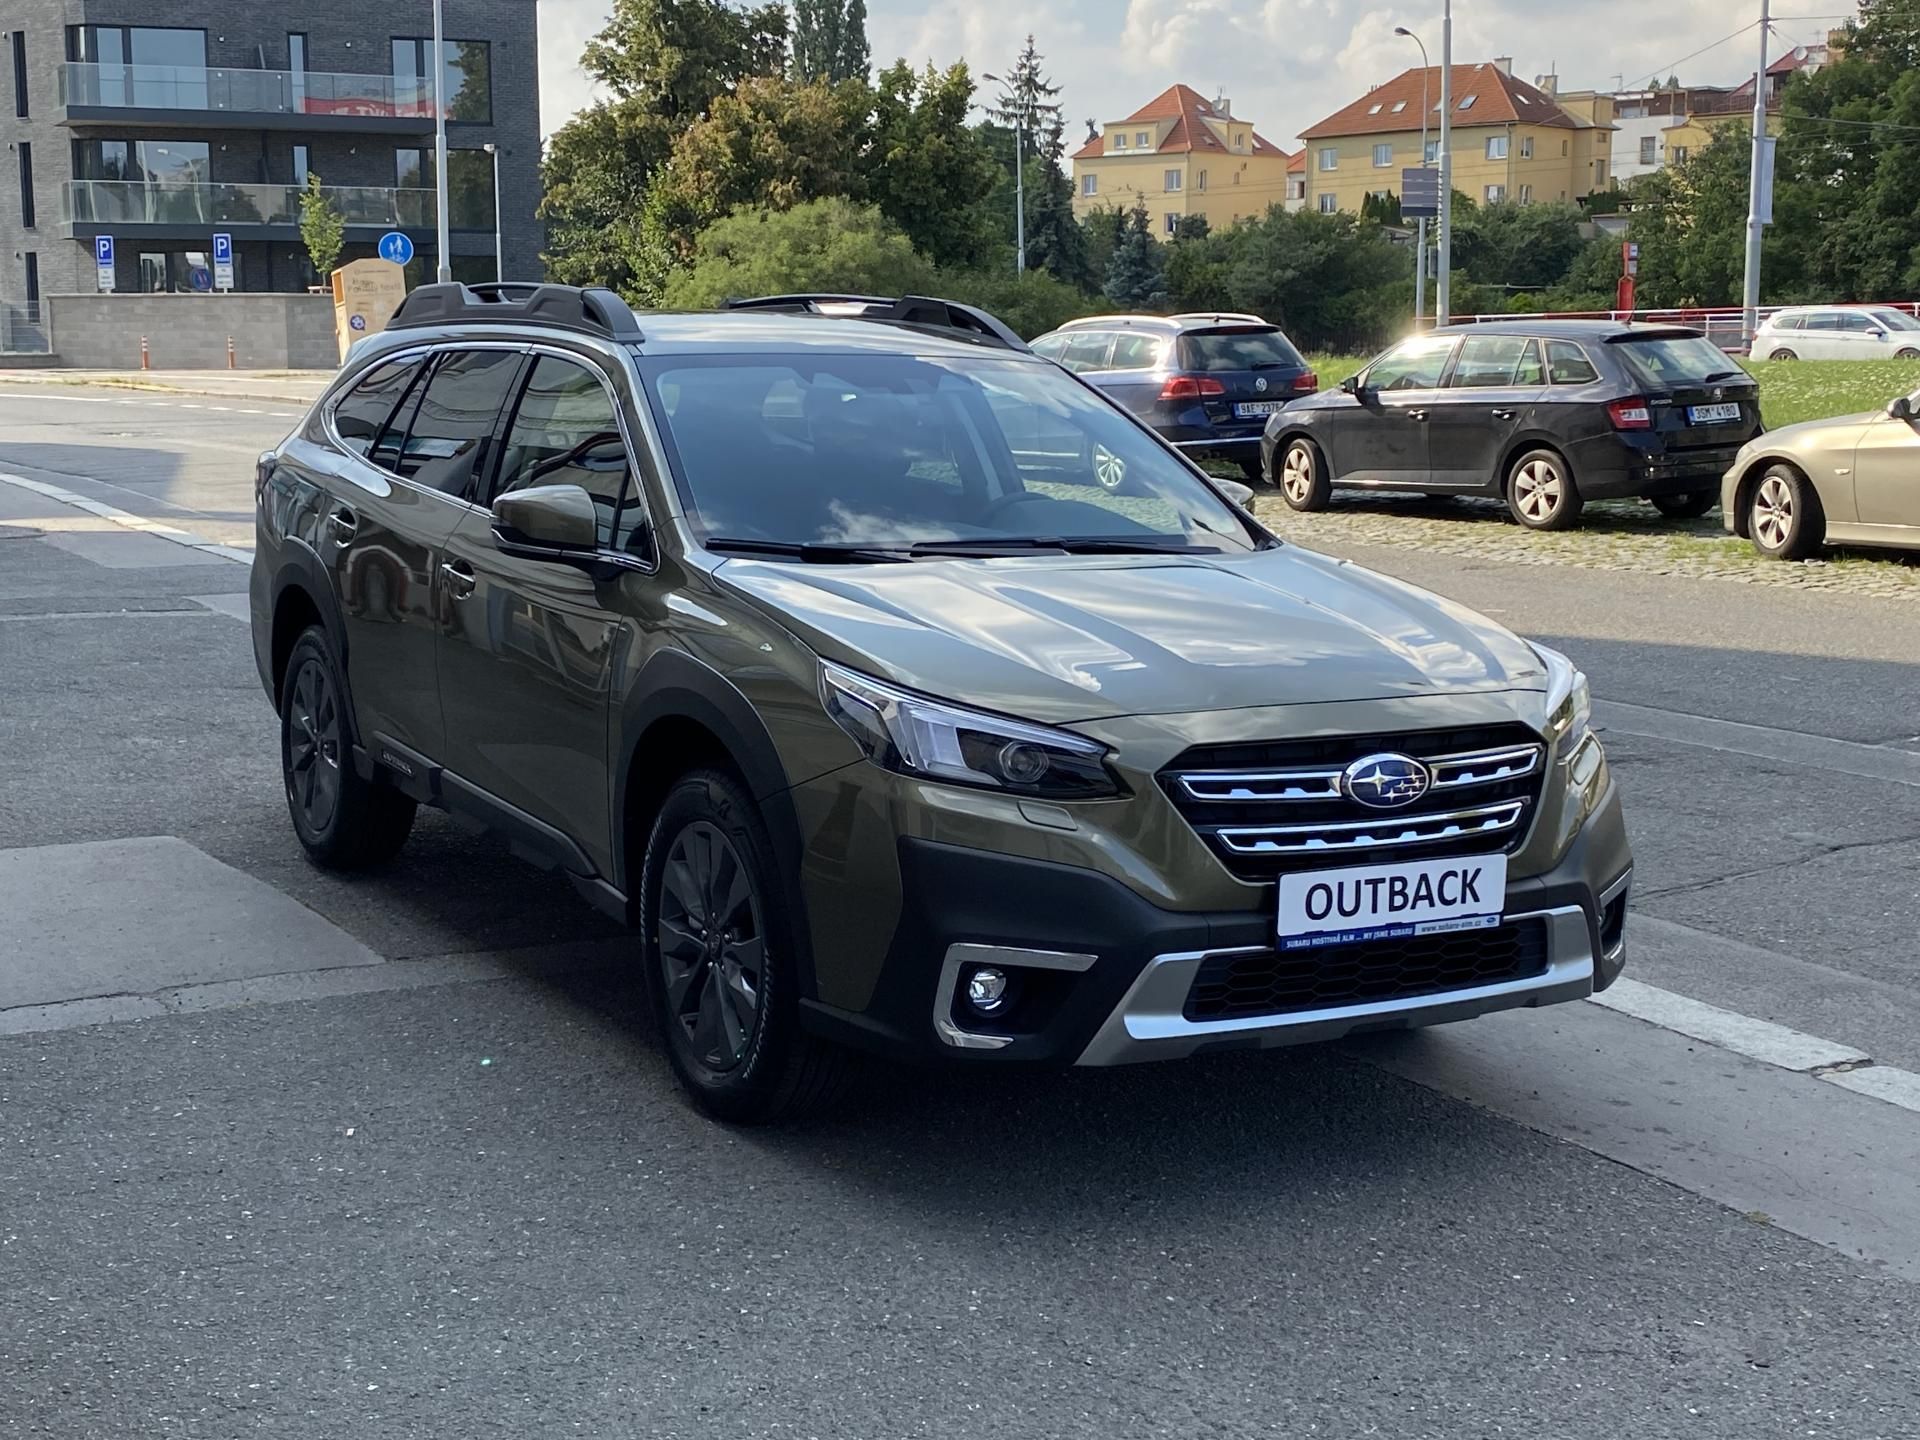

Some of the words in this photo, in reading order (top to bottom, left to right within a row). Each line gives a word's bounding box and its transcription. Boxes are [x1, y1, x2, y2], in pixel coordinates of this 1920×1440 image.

[99, 240, 110, 257] P
[217, 238, 228, 256] P
[1695, 408, 1711, 419] 3SM
[1305, 868, 1482, 920] OUTBACK
[1286, 938, 1311, 948] SUBARU
[1363, 932, 1373, 940] MY
[1390, 927, 1414, 937] SUBARU
